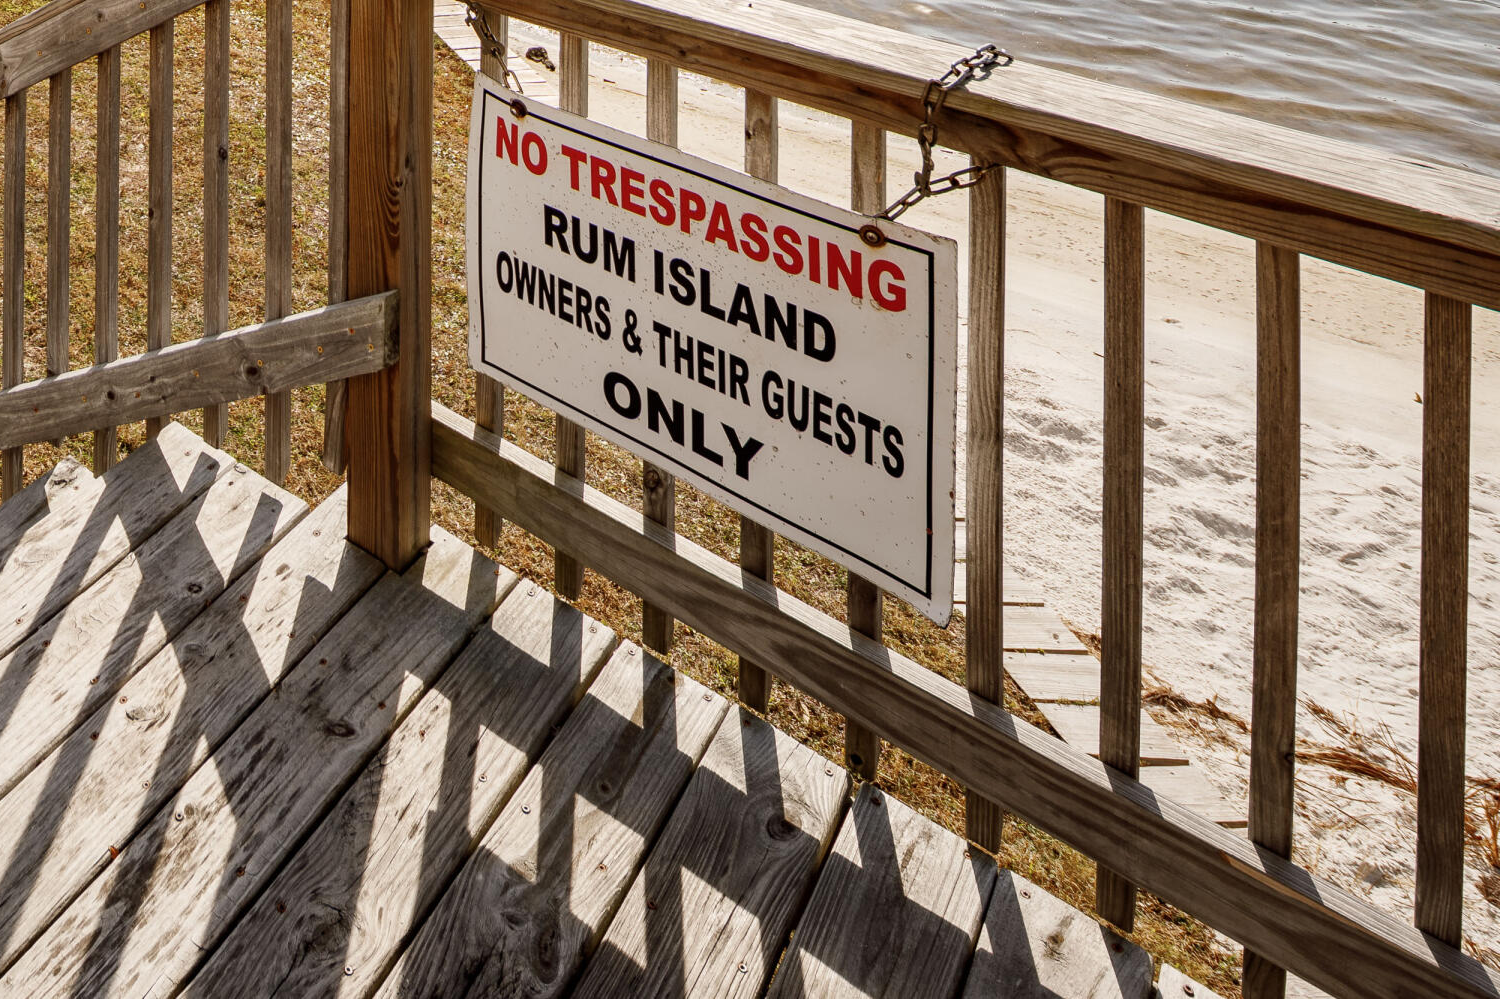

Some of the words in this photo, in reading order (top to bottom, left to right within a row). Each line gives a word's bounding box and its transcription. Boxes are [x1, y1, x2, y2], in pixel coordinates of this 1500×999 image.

[495, 115, 548, 176] NO
[561, 144, 907, 312] TRESPASSING
[543, 204, 636, 283] RUM
[653, 250, 837, 363] ISLAND
[496, 250, 612, 341] OWNERS
[622, 307, 643, 355] &
[652, 321, 751, 407] THEIR
[761, 369, 905, 479] GUESTS
[603, 371, 764, 481] ONLY
